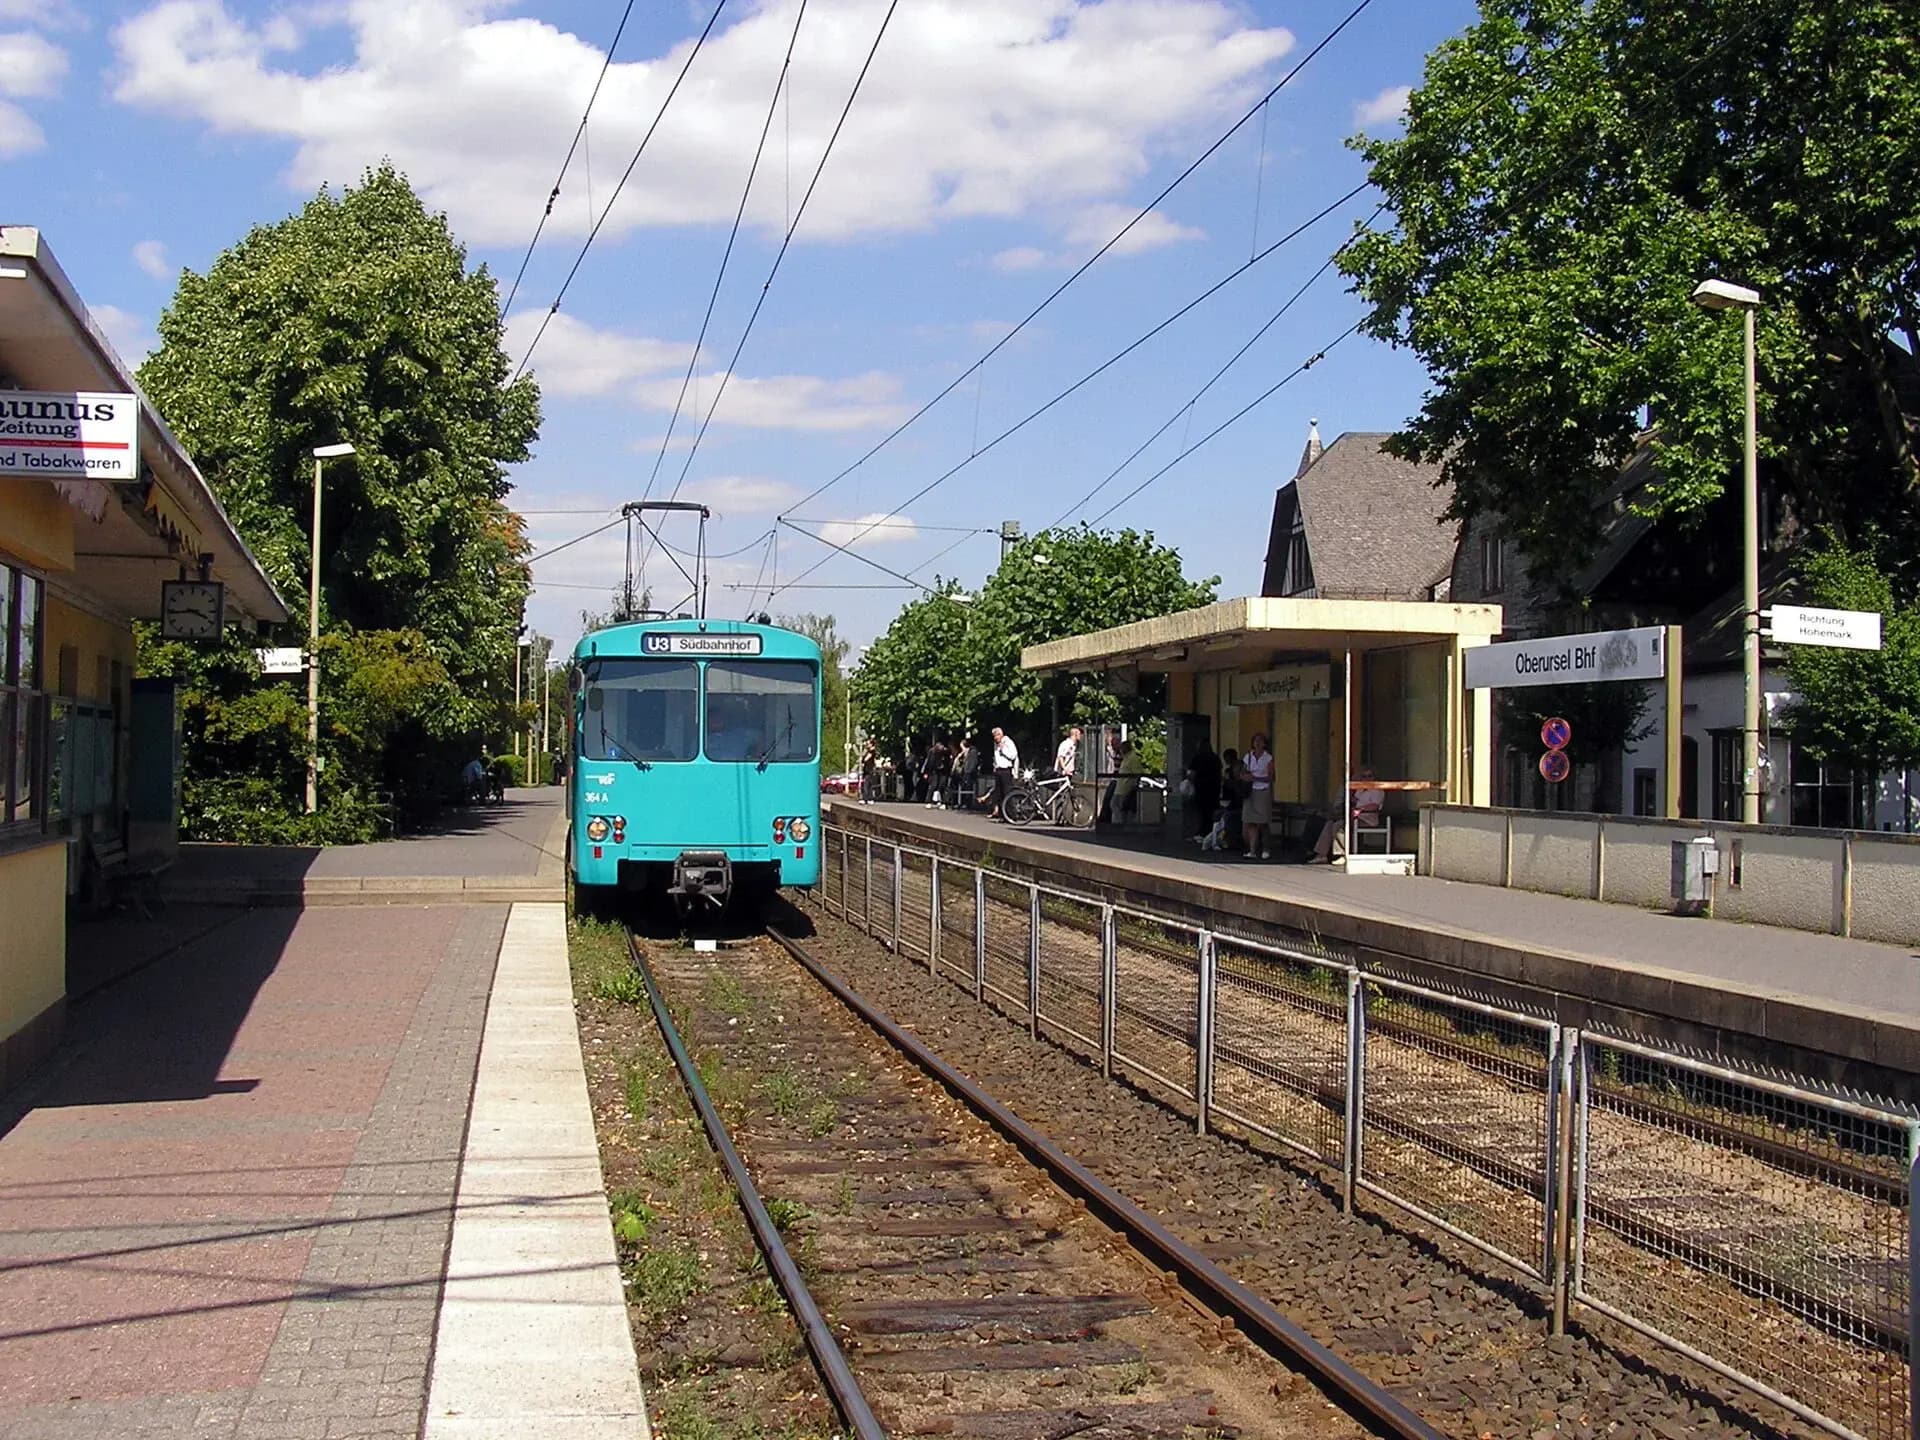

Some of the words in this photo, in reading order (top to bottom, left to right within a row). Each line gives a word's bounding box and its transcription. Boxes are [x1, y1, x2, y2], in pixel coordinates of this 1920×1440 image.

[22, 453, 121, 469] Tabakwaren
[1799, 613, 1845, 627] Richtung
[1799, 627, 1853, 640] Hohemark
[647, 636, 670, 651] U3
[679, 638, 752, 650] Südbahnhof
[1515, 648, 1571, 674] Oberursel
[1575, 646, 1597, 669] Bhf
[601, 792, 609, 803] A
